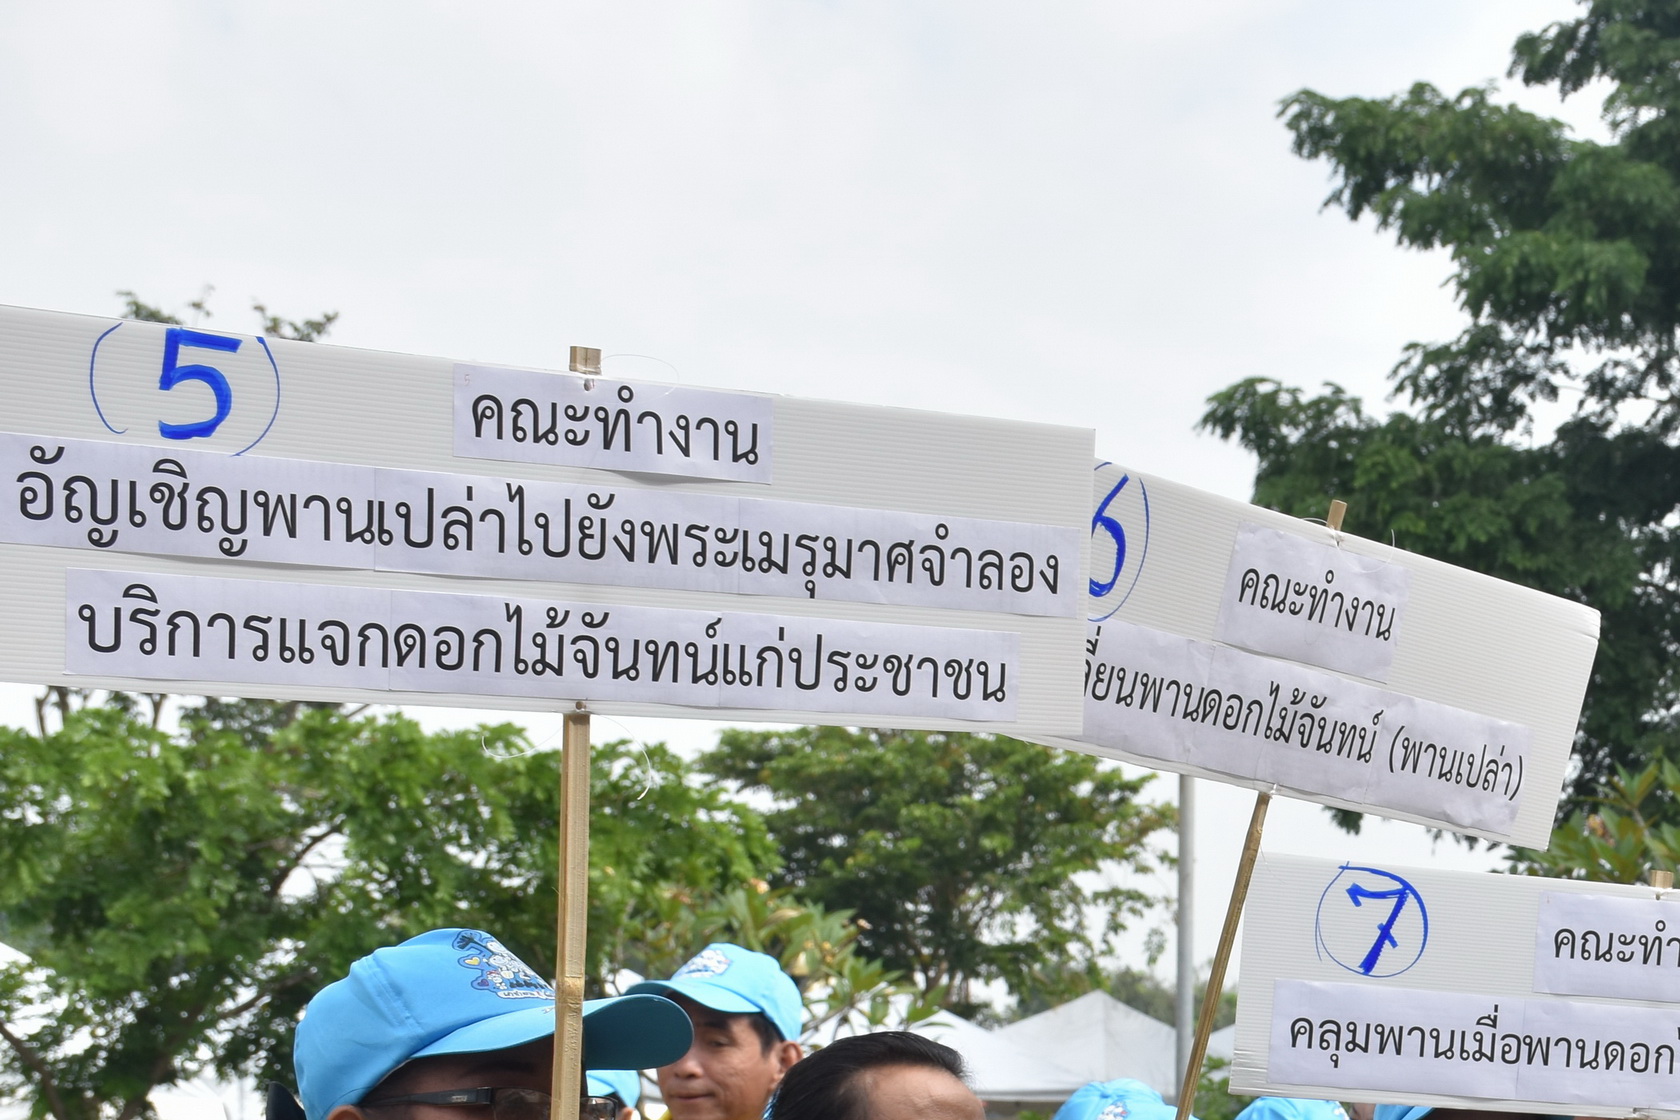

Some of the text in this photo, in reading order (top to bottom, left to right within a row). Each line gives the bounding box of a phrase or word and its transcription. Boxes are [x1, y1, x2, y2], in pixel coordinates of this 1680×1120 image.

[158, 327, 243, 440] 5
[471, 384, 759, 465] คณะทำงาน
[16, 445, 1059, 598] อัญเชิญพานเปล่าไปยังพระเมรุมาศจำลอง
[78, 584, 1006, 702] บริการแจกดอกไม้จันทน์แก่ประชาชน
[1239, 569, 1396, 641] คณะทำงาน
[1084, 625, 1523, 802] ี่ยนพานดอกไม้จันทน์ (พานเปล่า)
[1346, 882, 1410, 976] 7
